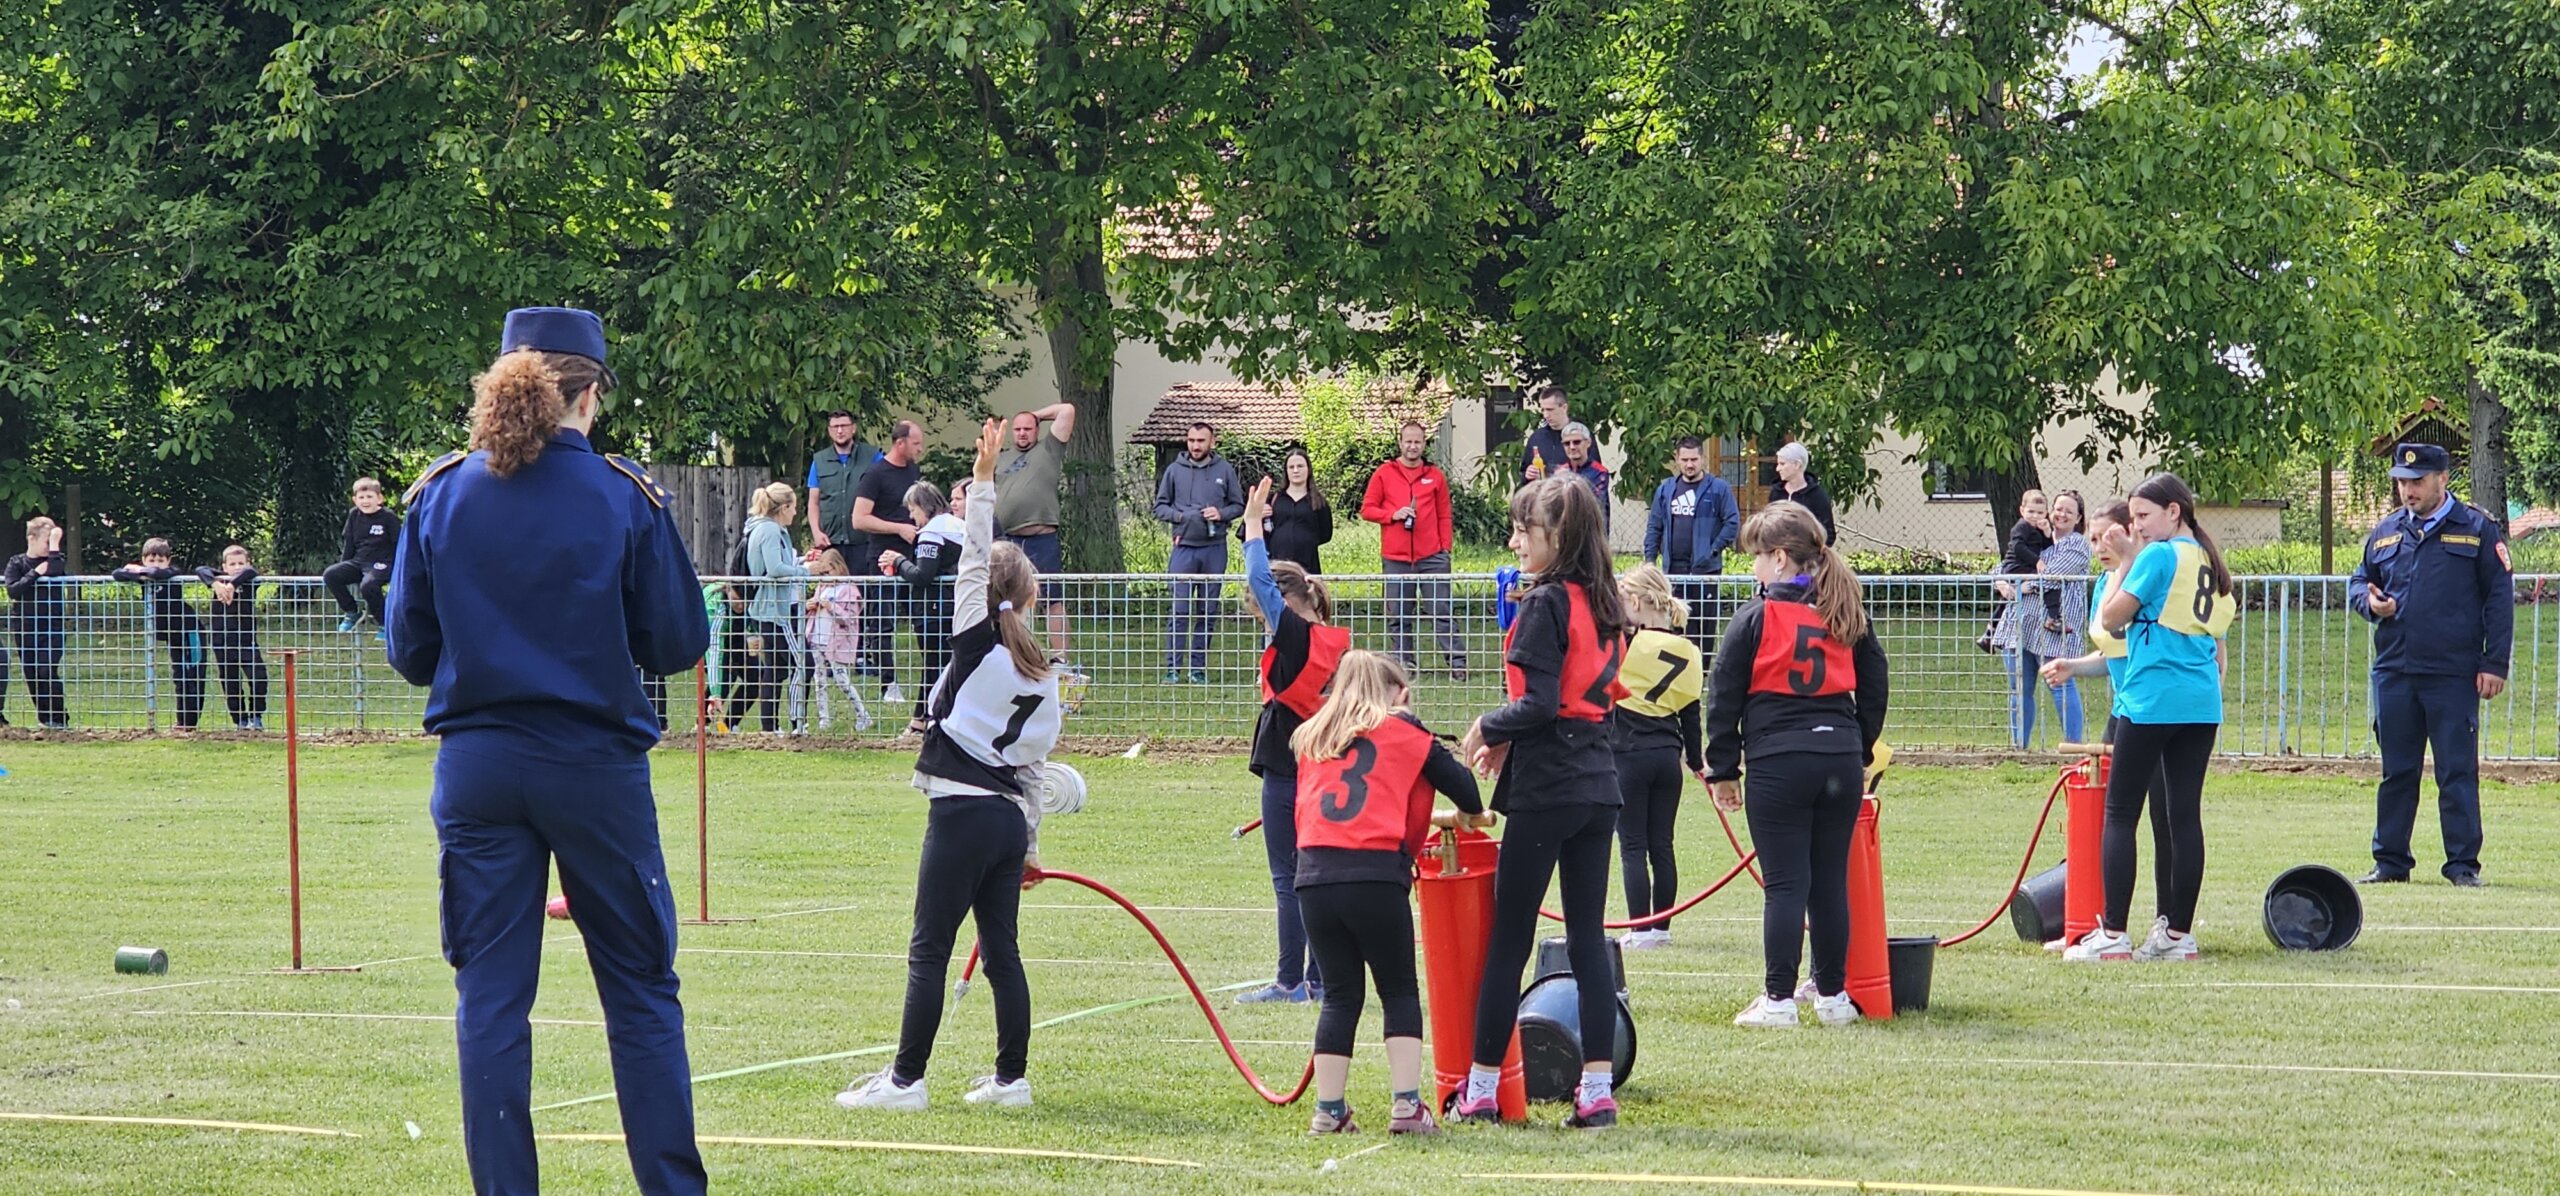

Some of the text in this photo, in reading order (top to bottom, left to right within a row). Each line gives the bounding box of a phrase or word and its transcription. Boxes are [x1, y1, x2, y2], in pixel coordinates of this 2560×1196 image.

[2193, 565, 2217, 624] 8
[1583, 629, 1620, 710] 2
[1644, 649, 1689, 705] 7
[1788, 625, 1828, 695] 5
[991, 694, 1045, 757] 1
[1320, 736, 1377, 822] 3
